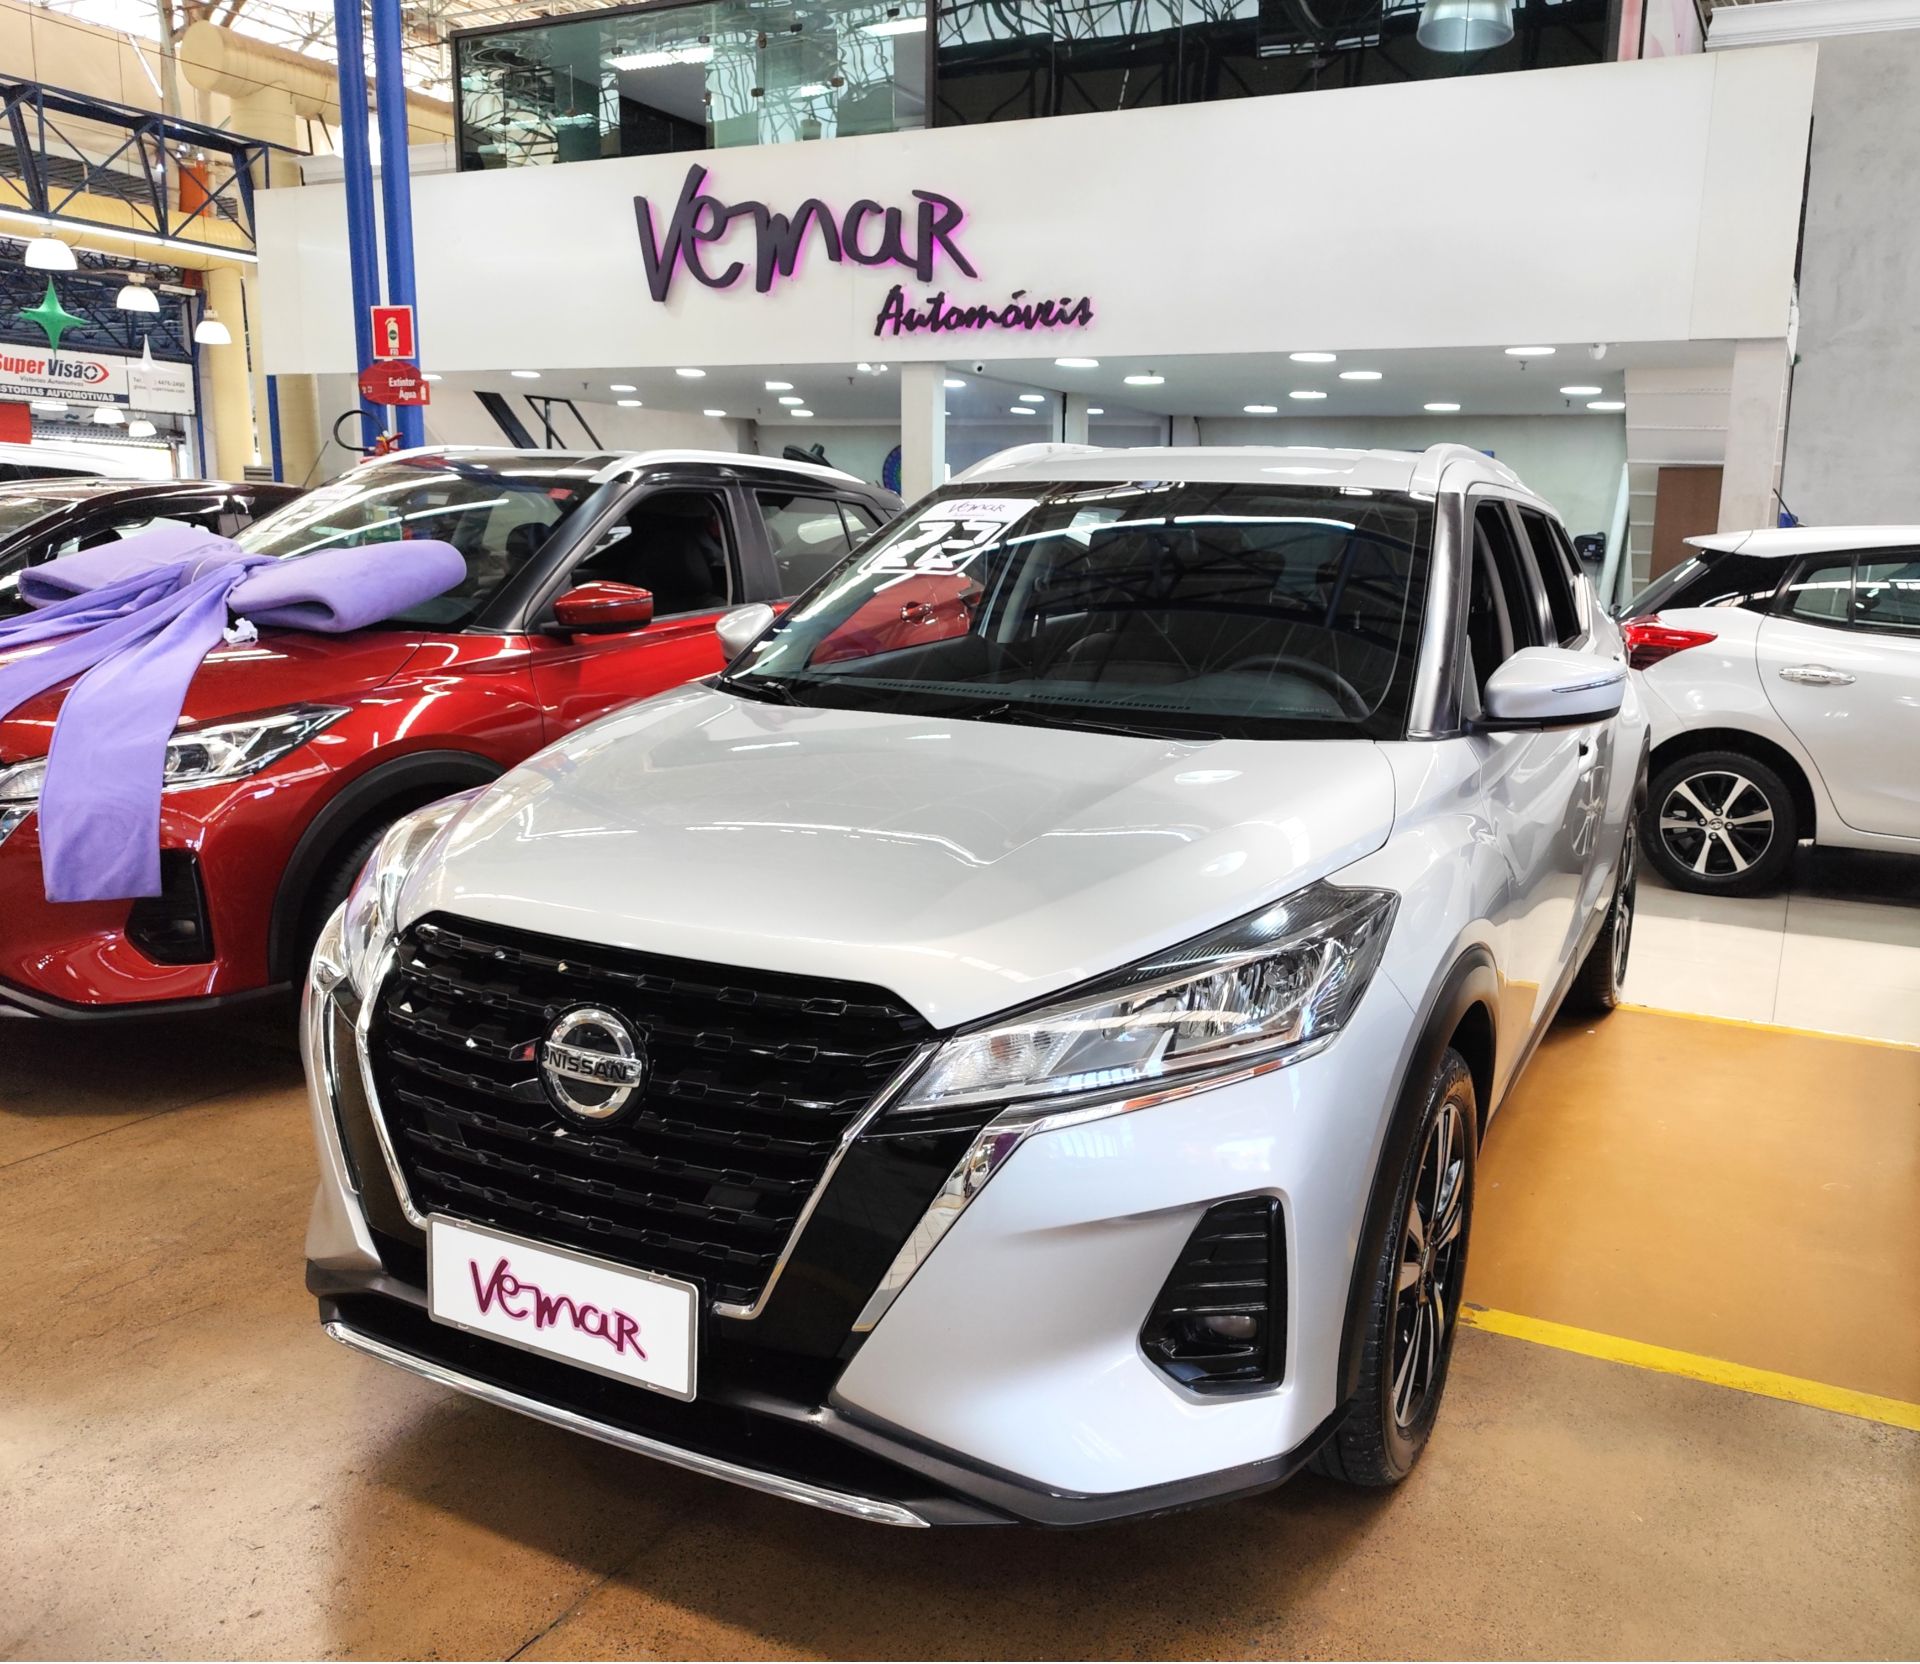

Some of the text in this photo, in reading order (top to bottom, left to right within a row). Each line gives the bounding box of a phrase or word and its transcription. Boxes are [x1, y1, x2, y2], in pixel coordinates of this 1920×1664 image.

[874, 284, 1094, 337] Automóveis
[48, 357, 99, 381] Visão
[388, 377, 416, 388] Extintor
[46, 387, 115, 402] AUTOMOTIVAS
[399, 386, 417, 401] Água
[549, 1050, 627, 1080] NISSAN
